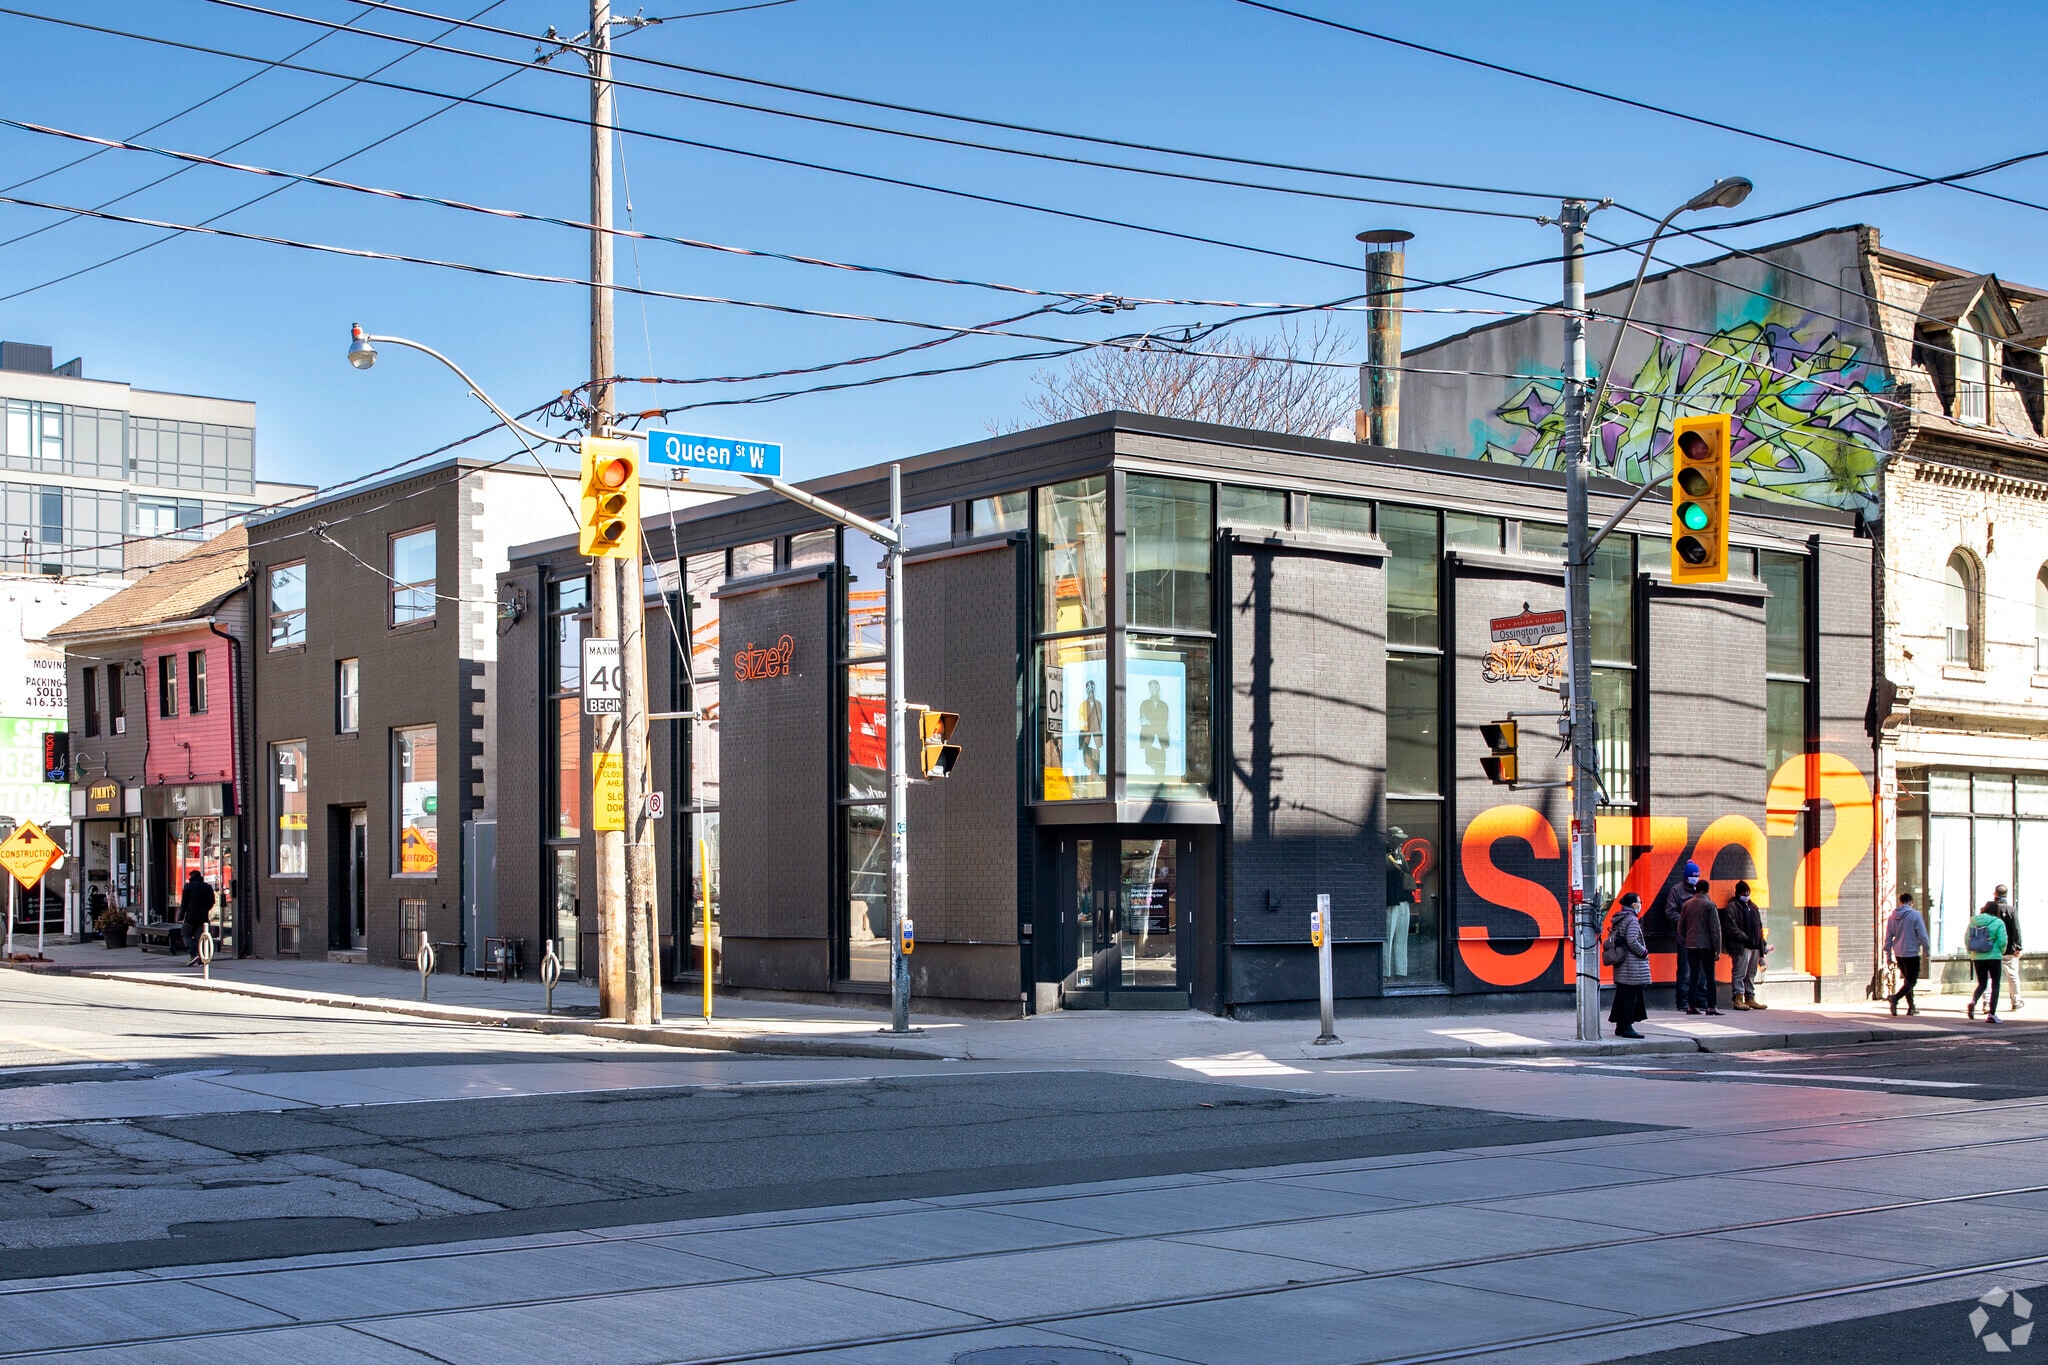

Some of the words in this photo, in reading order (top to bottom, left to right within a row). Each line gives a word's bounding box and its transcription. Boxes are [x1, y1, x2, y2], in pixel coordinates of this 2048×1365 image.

[665, 436, 731, 465] Queen
[735, 444, 746, 457] St
[749, 446, 765, 469] W
[1535, 616, 1561, 624] DISTRICT
[1499, 627, 1539, 640] Ossington
[1541, 625, 1558, 634] Ave.
[734, 635, 794, 682] size?
[1490, 636, 1568, 679] size?
[26, 677, 62, 687] PACKING
[36, 687, 63, 697] SOLD
[46, 734, 55, 770] COFFEE
[599, 761, 617, 769] CURB
[90, 785, 117, 799] JIMMY'S
[96, 803, 111, 813] COFFEE
[0, 849, 56, 859] CONSTRUCTION
[1458, 752, 1875, 986] sze?
